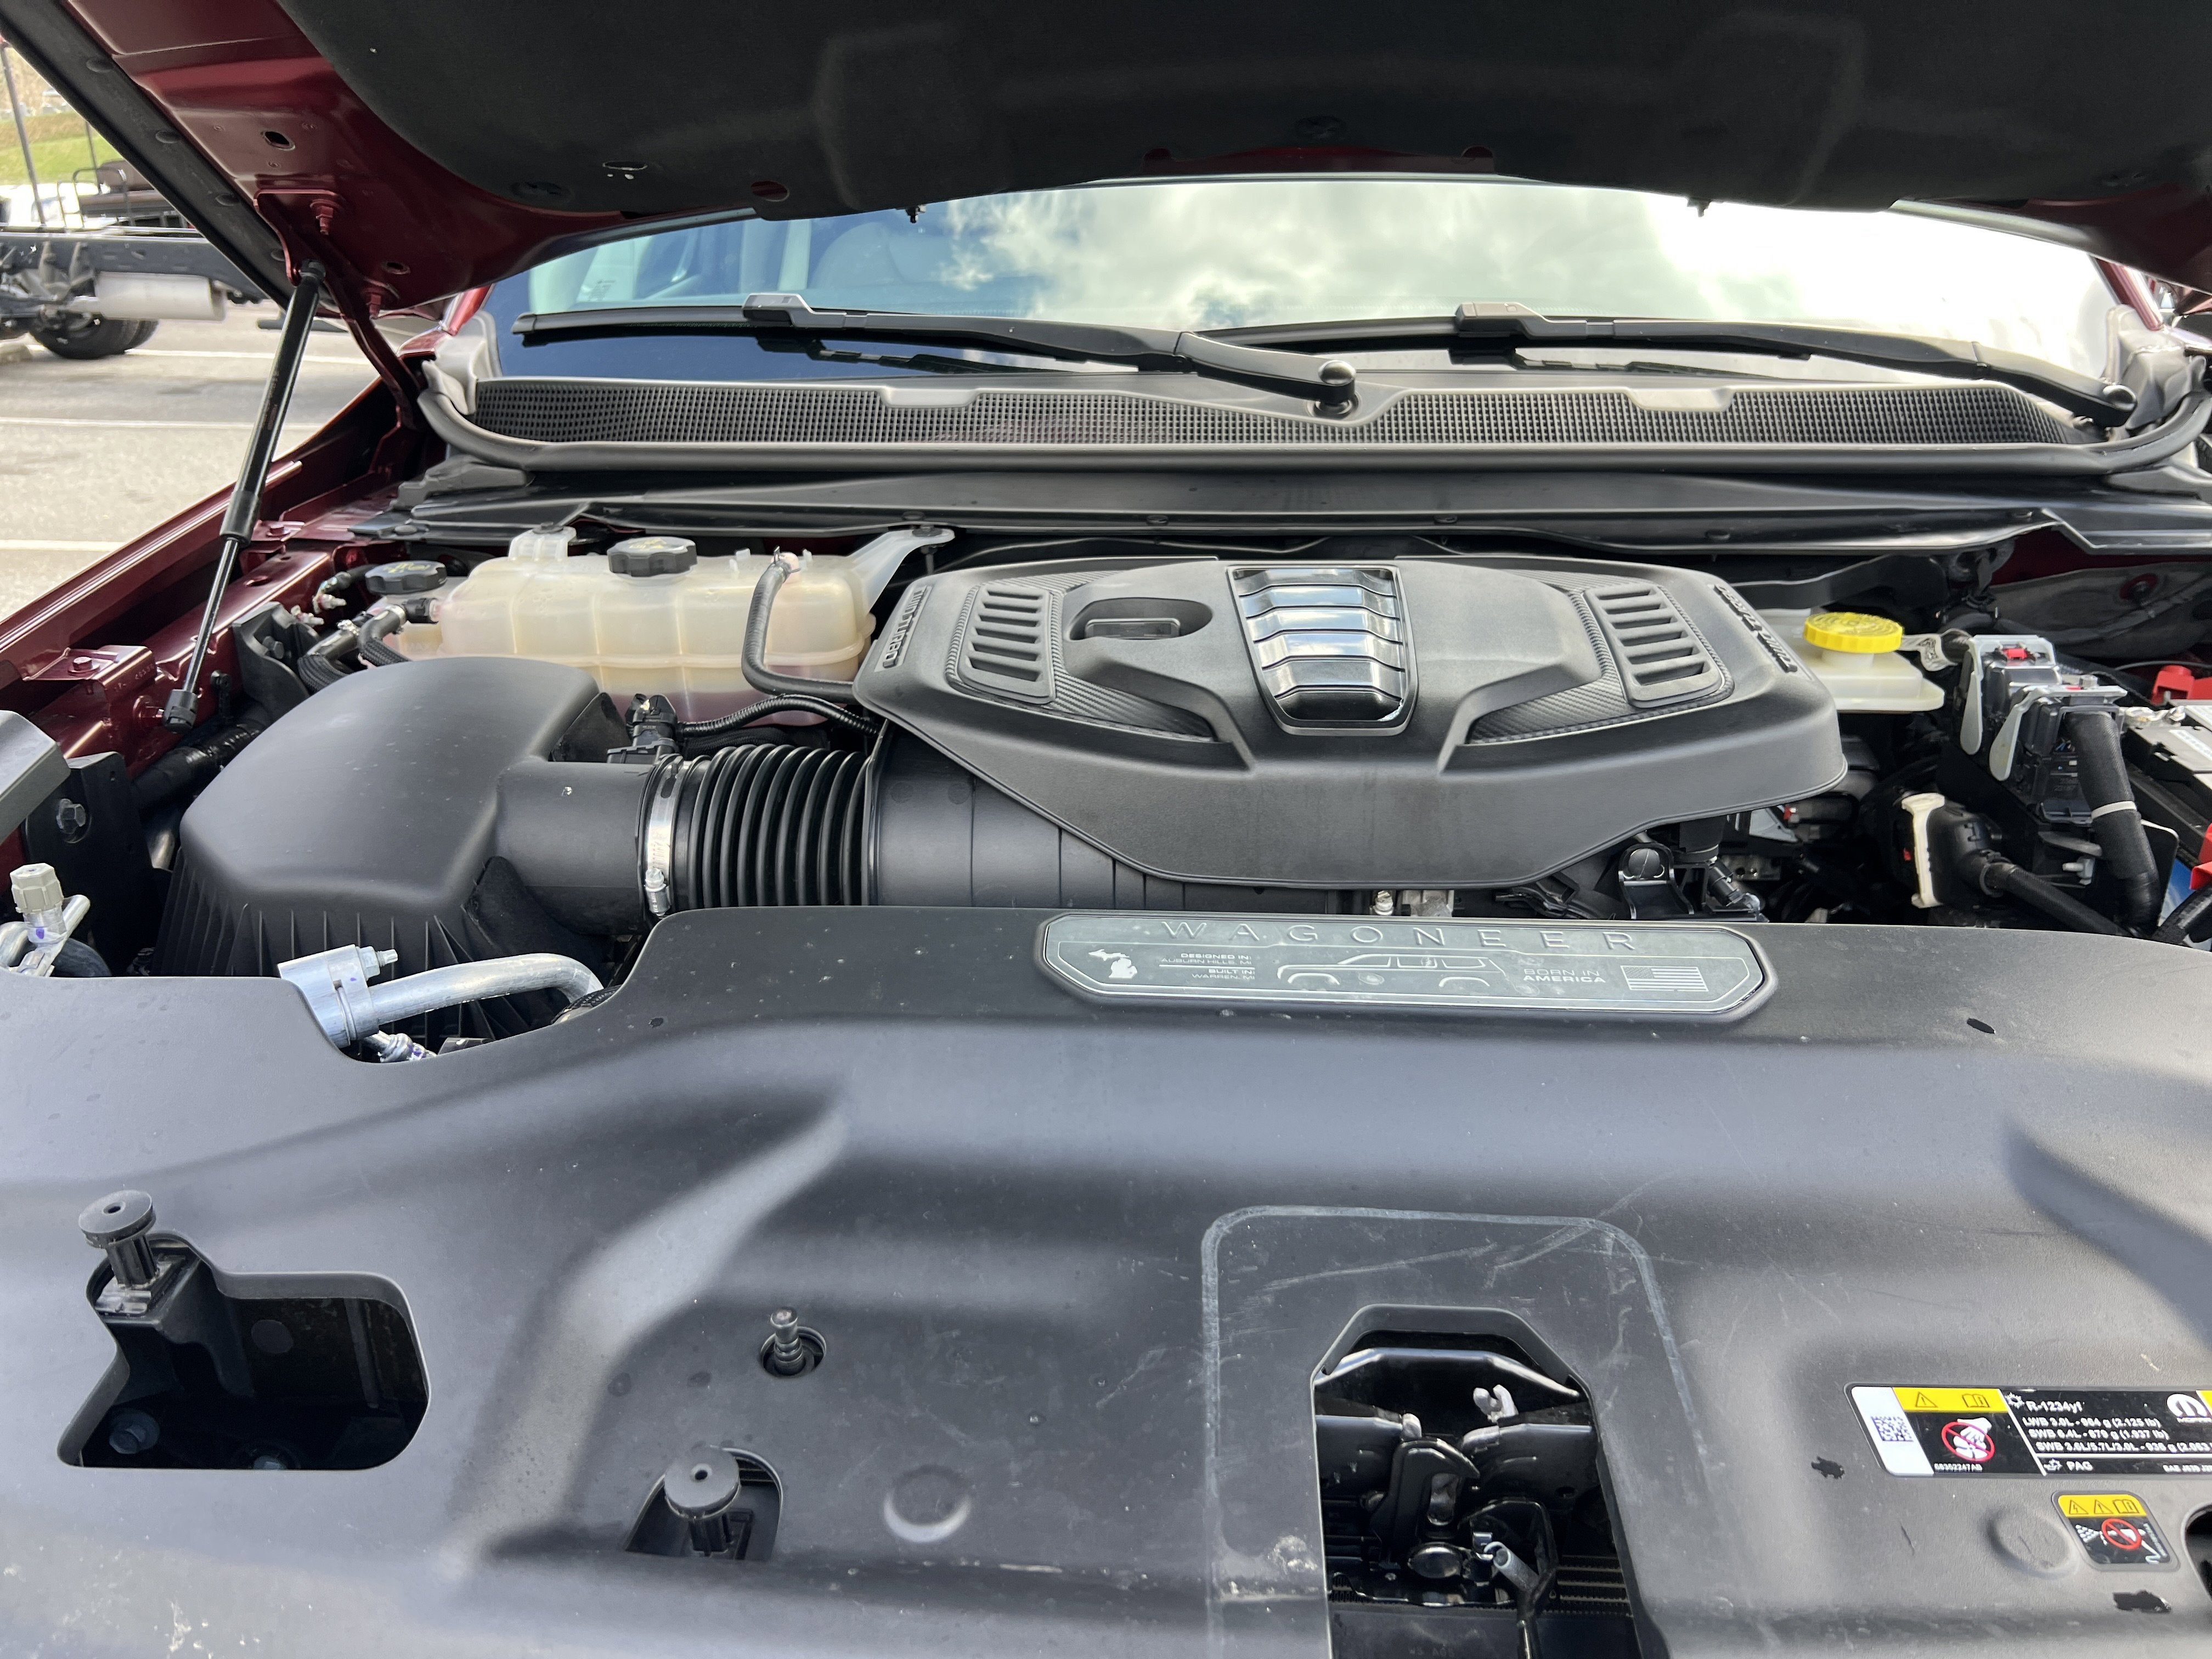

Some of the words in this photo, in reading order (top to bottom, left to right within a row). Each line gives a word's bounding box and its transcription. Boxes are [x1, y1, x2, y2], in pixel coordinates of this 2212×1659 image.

[883, 615, 913, 668] TURBO
[1161, 921, 1635, 950] WAGONEER
[2025, 1401, 2083, 1414] R-1234yf
[2022, 1417, 2049, 1427] LWB
[2050, 1417, 2074, 1427] 3.0L
[2112, 1418, 2145, 1429] (2.125
[2144, 1418, 2162, 1429] lb)
[2028, 1429, 2056, 1439] SWB
[2057, 1429, 2082, 1439] 6.4L
[2152, 1429, 2170, 1441] lb)
[2035, 1441, 2064, 1452] SWB
[2066, 1461, 2094, 1471] PAG
